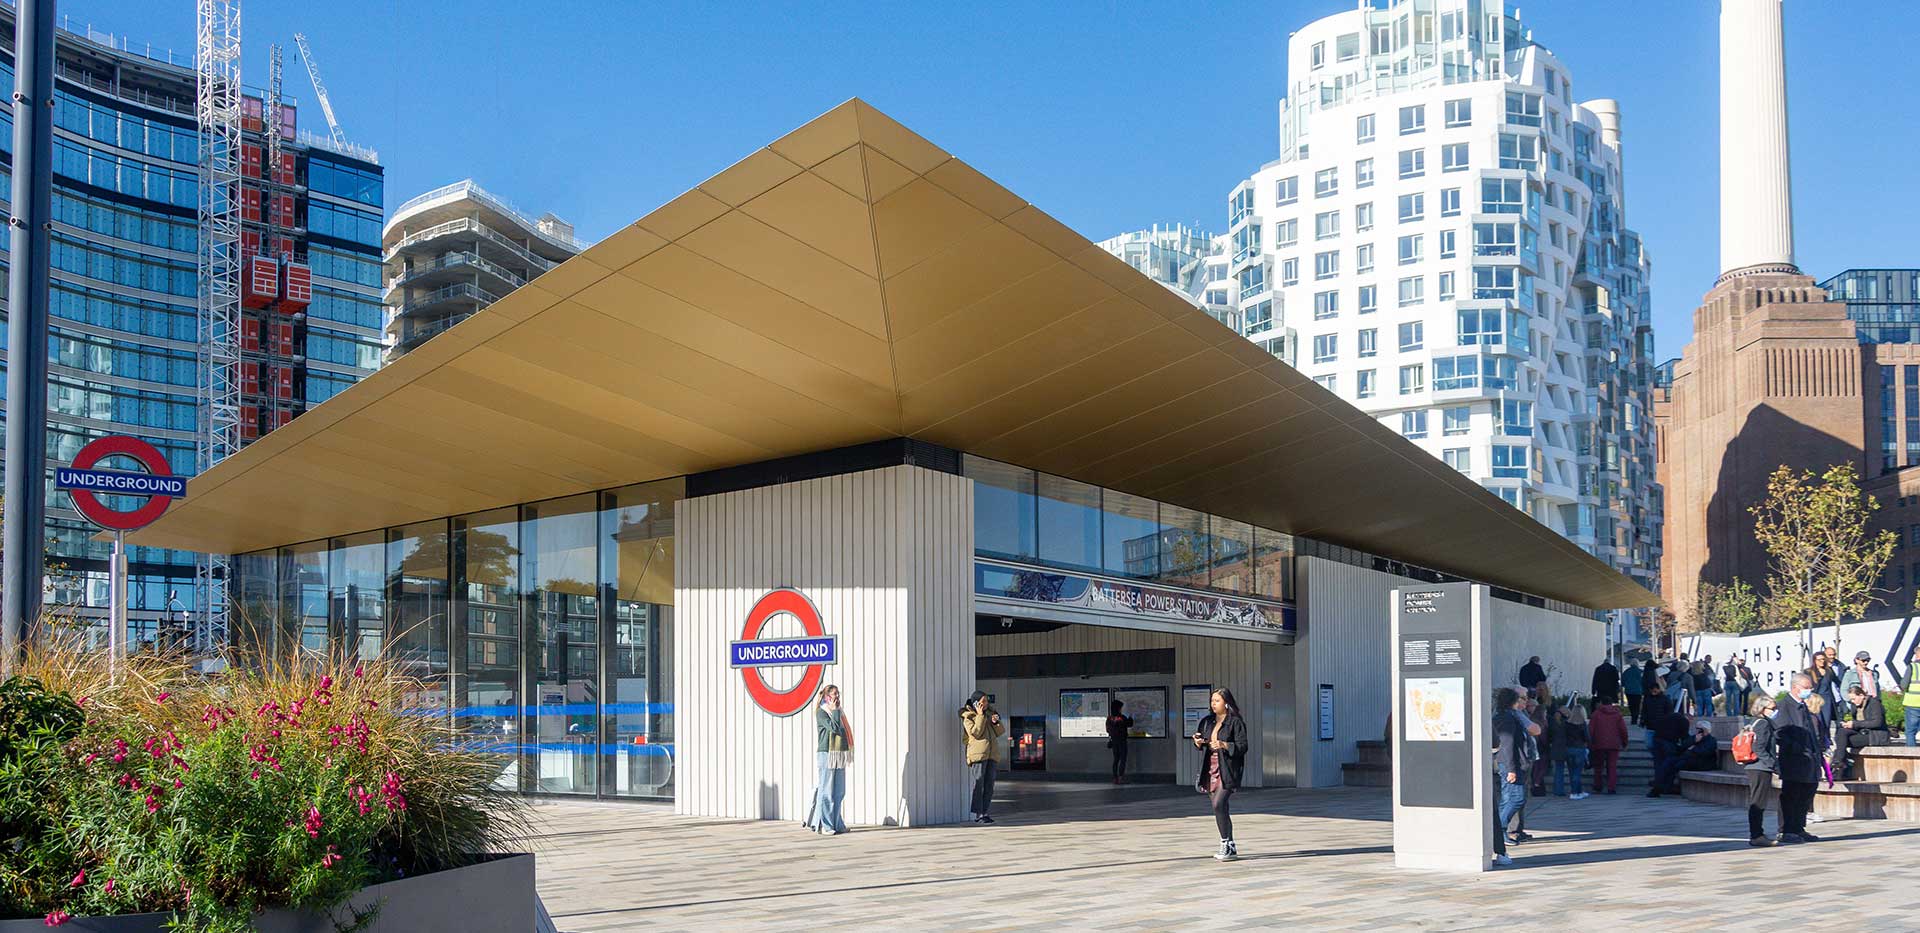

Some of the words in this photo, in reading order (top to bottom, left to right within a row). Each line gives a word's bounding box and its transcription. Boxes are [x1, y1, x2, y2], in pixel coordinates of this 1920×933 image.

[60, 471, 182, 492] UNDERGROUND
[1092, 586, 1143, 608] BATTERSEA
[1144, 593, 1175, 610] POWER
[1177, 598, 1210, 616] STATION
[738, 643, 828, 661] UNDERGROUND
[1743, 645, 1782, 664] THIS
